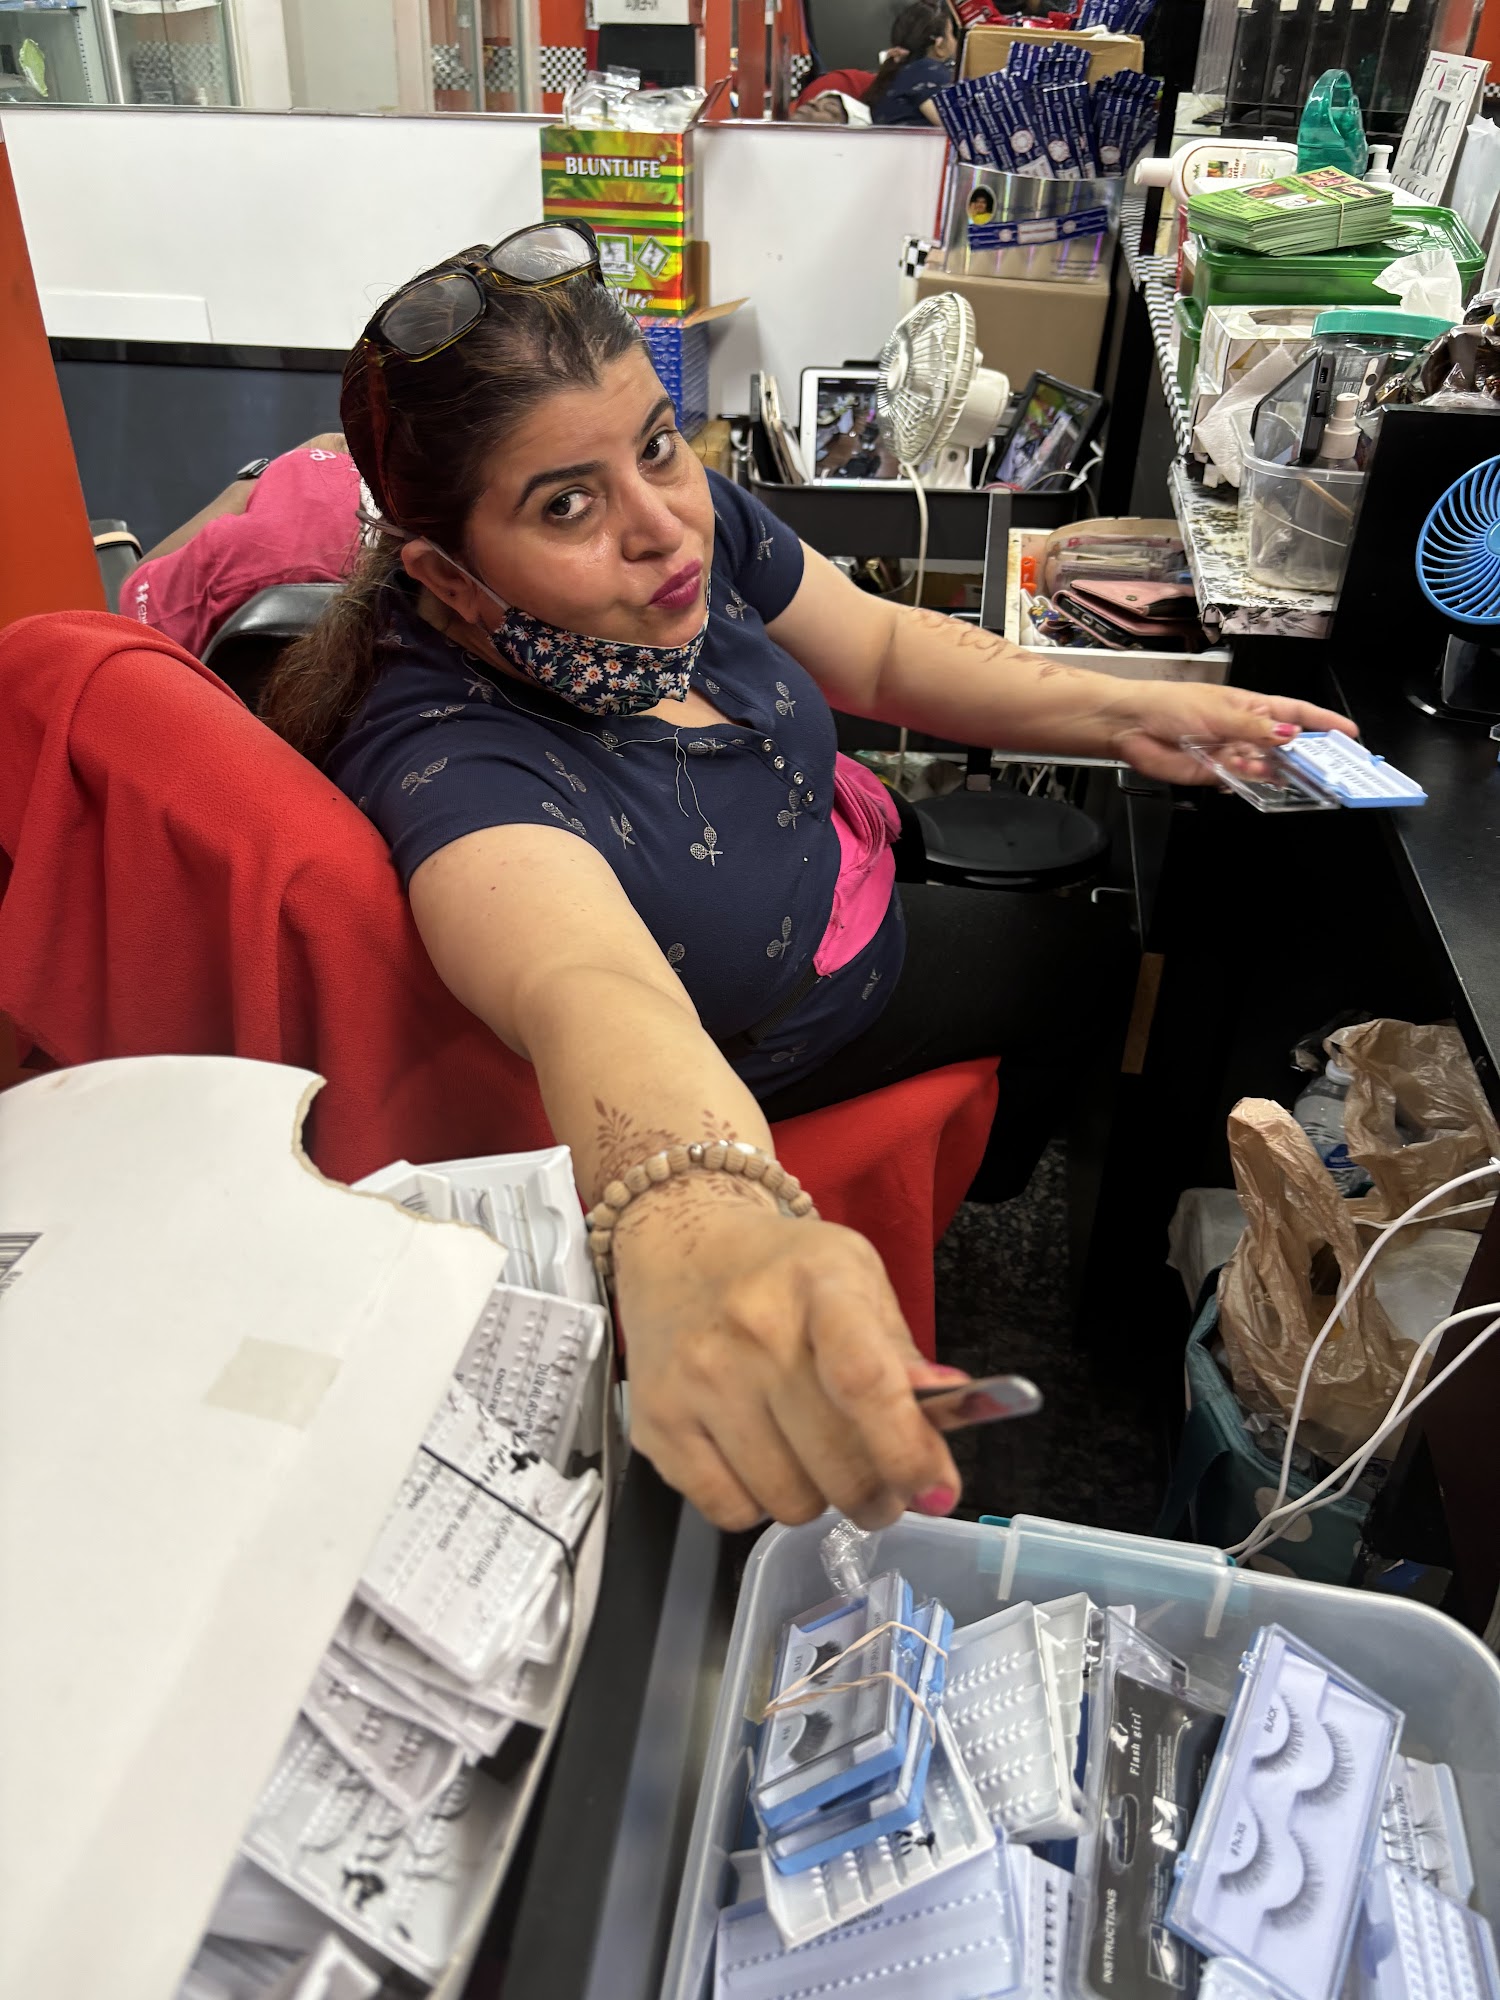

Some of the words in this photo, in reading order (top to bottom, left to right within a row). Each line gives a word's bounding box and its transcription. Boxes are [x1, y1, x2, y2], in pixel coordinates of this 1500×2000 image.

[565, 156, 661, 179] BLUNTLIFE
[1130, 1711, 1143, 1740] girl
[1263, 1704, 1279, 1735] BLACK
[1128, 1742, 1141, 1777] Flash
[1102, 1887, 1118, 1984] INSTRUCTIONS
